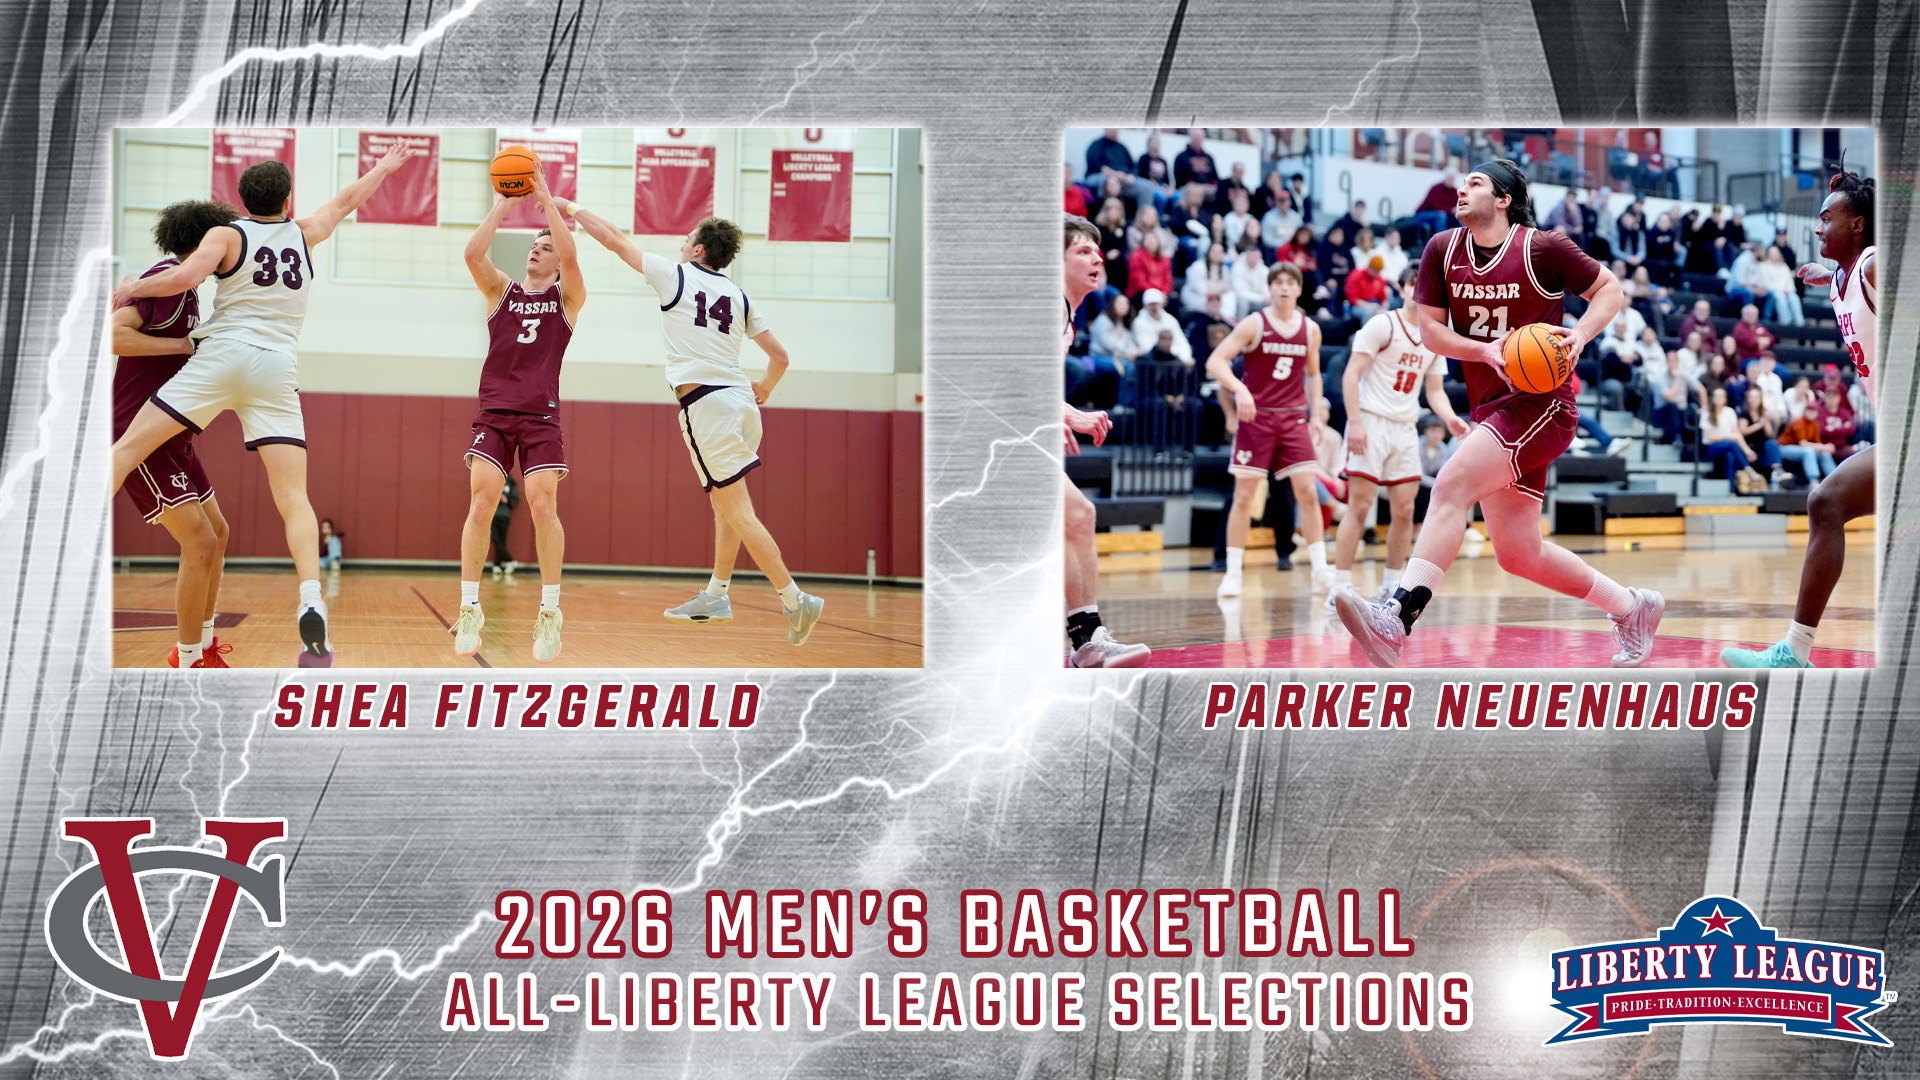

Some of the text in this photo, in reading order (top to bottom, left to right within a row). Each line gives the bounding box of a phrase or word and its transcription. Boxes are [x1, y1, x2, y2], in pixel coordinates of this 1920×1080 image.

[253, 246, 303, 290] 33
[1450, 283, 1520, 299] VASSAR
[508, 300, 558, 315] VASSAR
[694, 290, 733, 334] 14
[516, 318, 541, 344] 3
[1468, 305, 1511, 338] 21
[1272, 356, 1294, 380] 5
[1398, 352, 1423, 369] RPI
